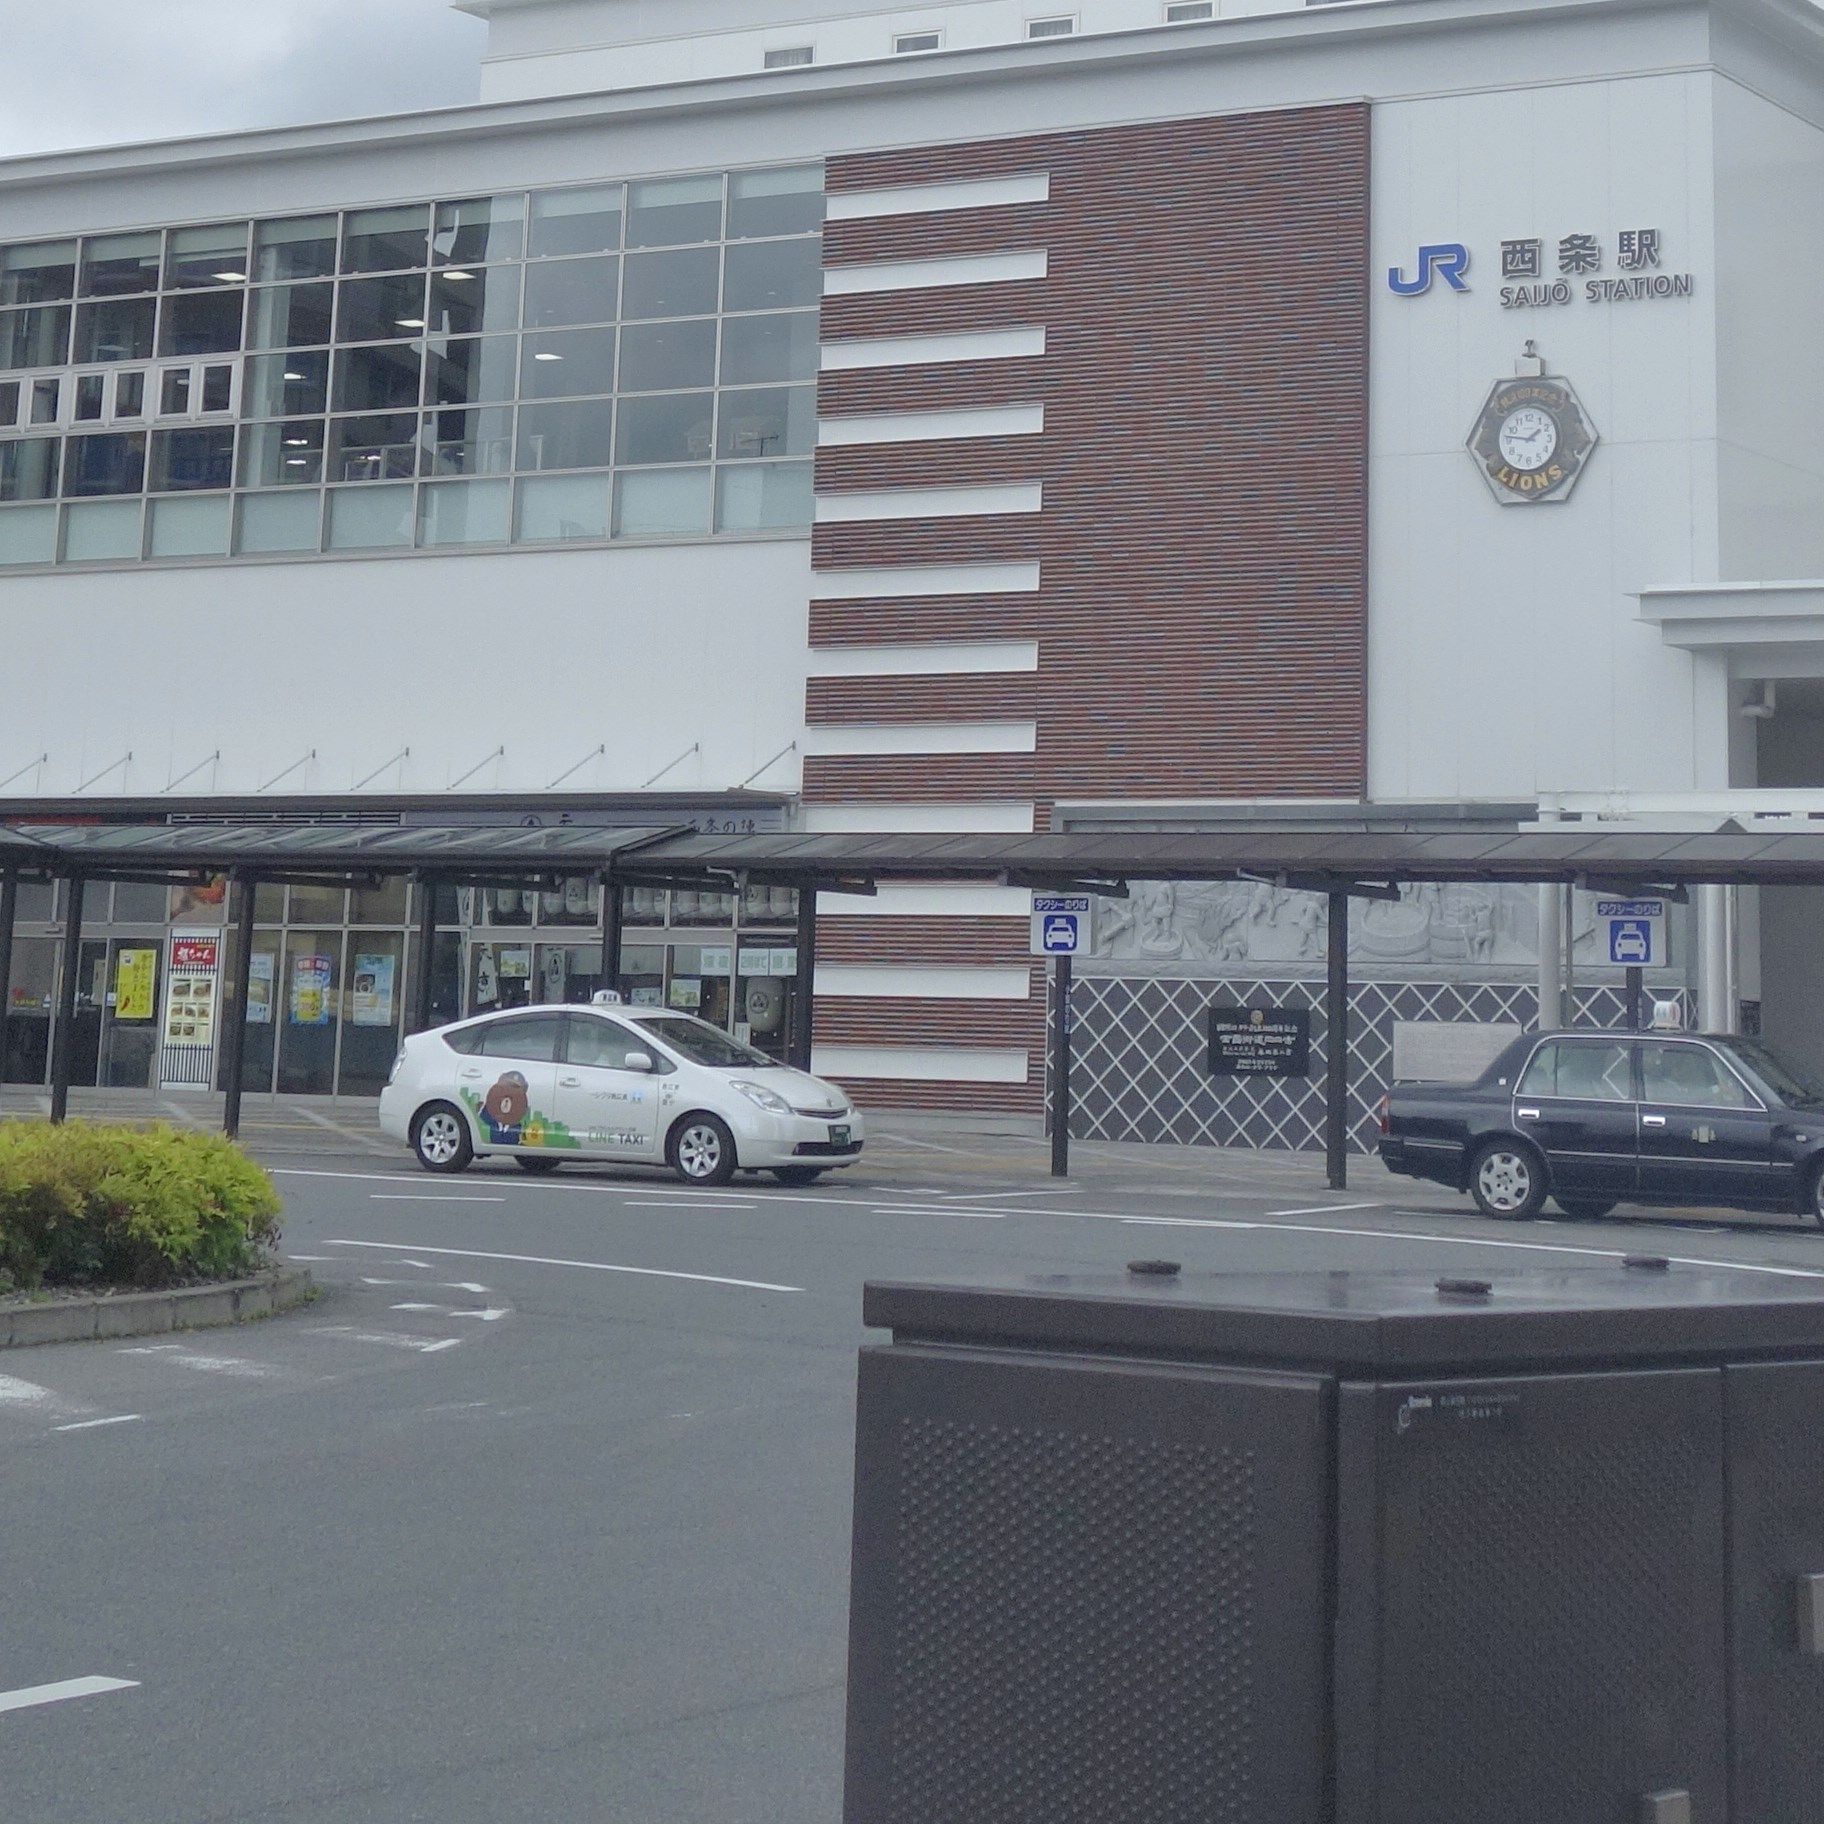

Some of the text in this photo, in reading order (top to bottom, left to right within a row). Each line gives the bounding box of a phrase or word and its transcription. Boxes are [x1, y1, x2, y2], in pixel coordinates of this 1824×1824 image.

[1500, 229, 1660, 277] 西条駅
[1388, 243, 1469, 294] JR
[1499, 274, 1692, 307] SAIJŌ STATION
[1498, 464, 1562, 490] LIONS
[1035, 899, 1088, 911] タクシーのりば
[1599, 903, 1662, 915] タクシーのりば
[618, 1133, 644, 1145] TAXI
